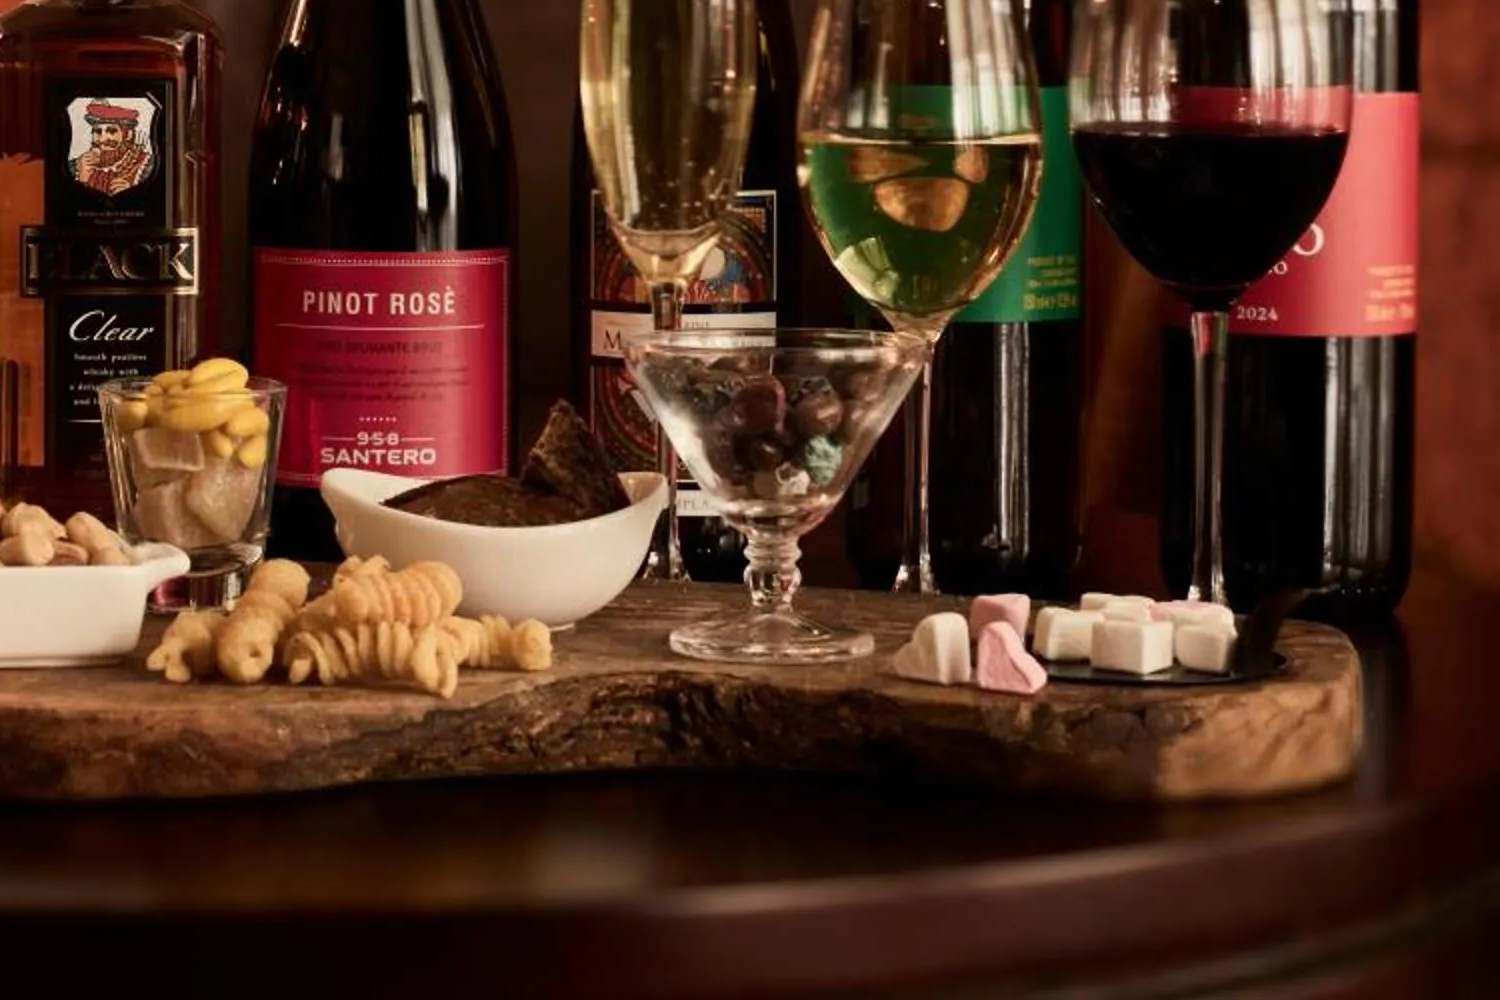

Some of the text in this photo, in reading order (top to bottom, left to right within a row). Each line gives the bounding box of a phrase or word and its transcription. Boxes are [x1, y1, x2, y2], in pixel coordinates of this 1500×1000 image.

[303, 291, 379, 316] PINOT
[1236, 306, 1278, 321] 2024
[68, 310, 155, 341] Clear
[320, 447, 437, 466] SANTERO
